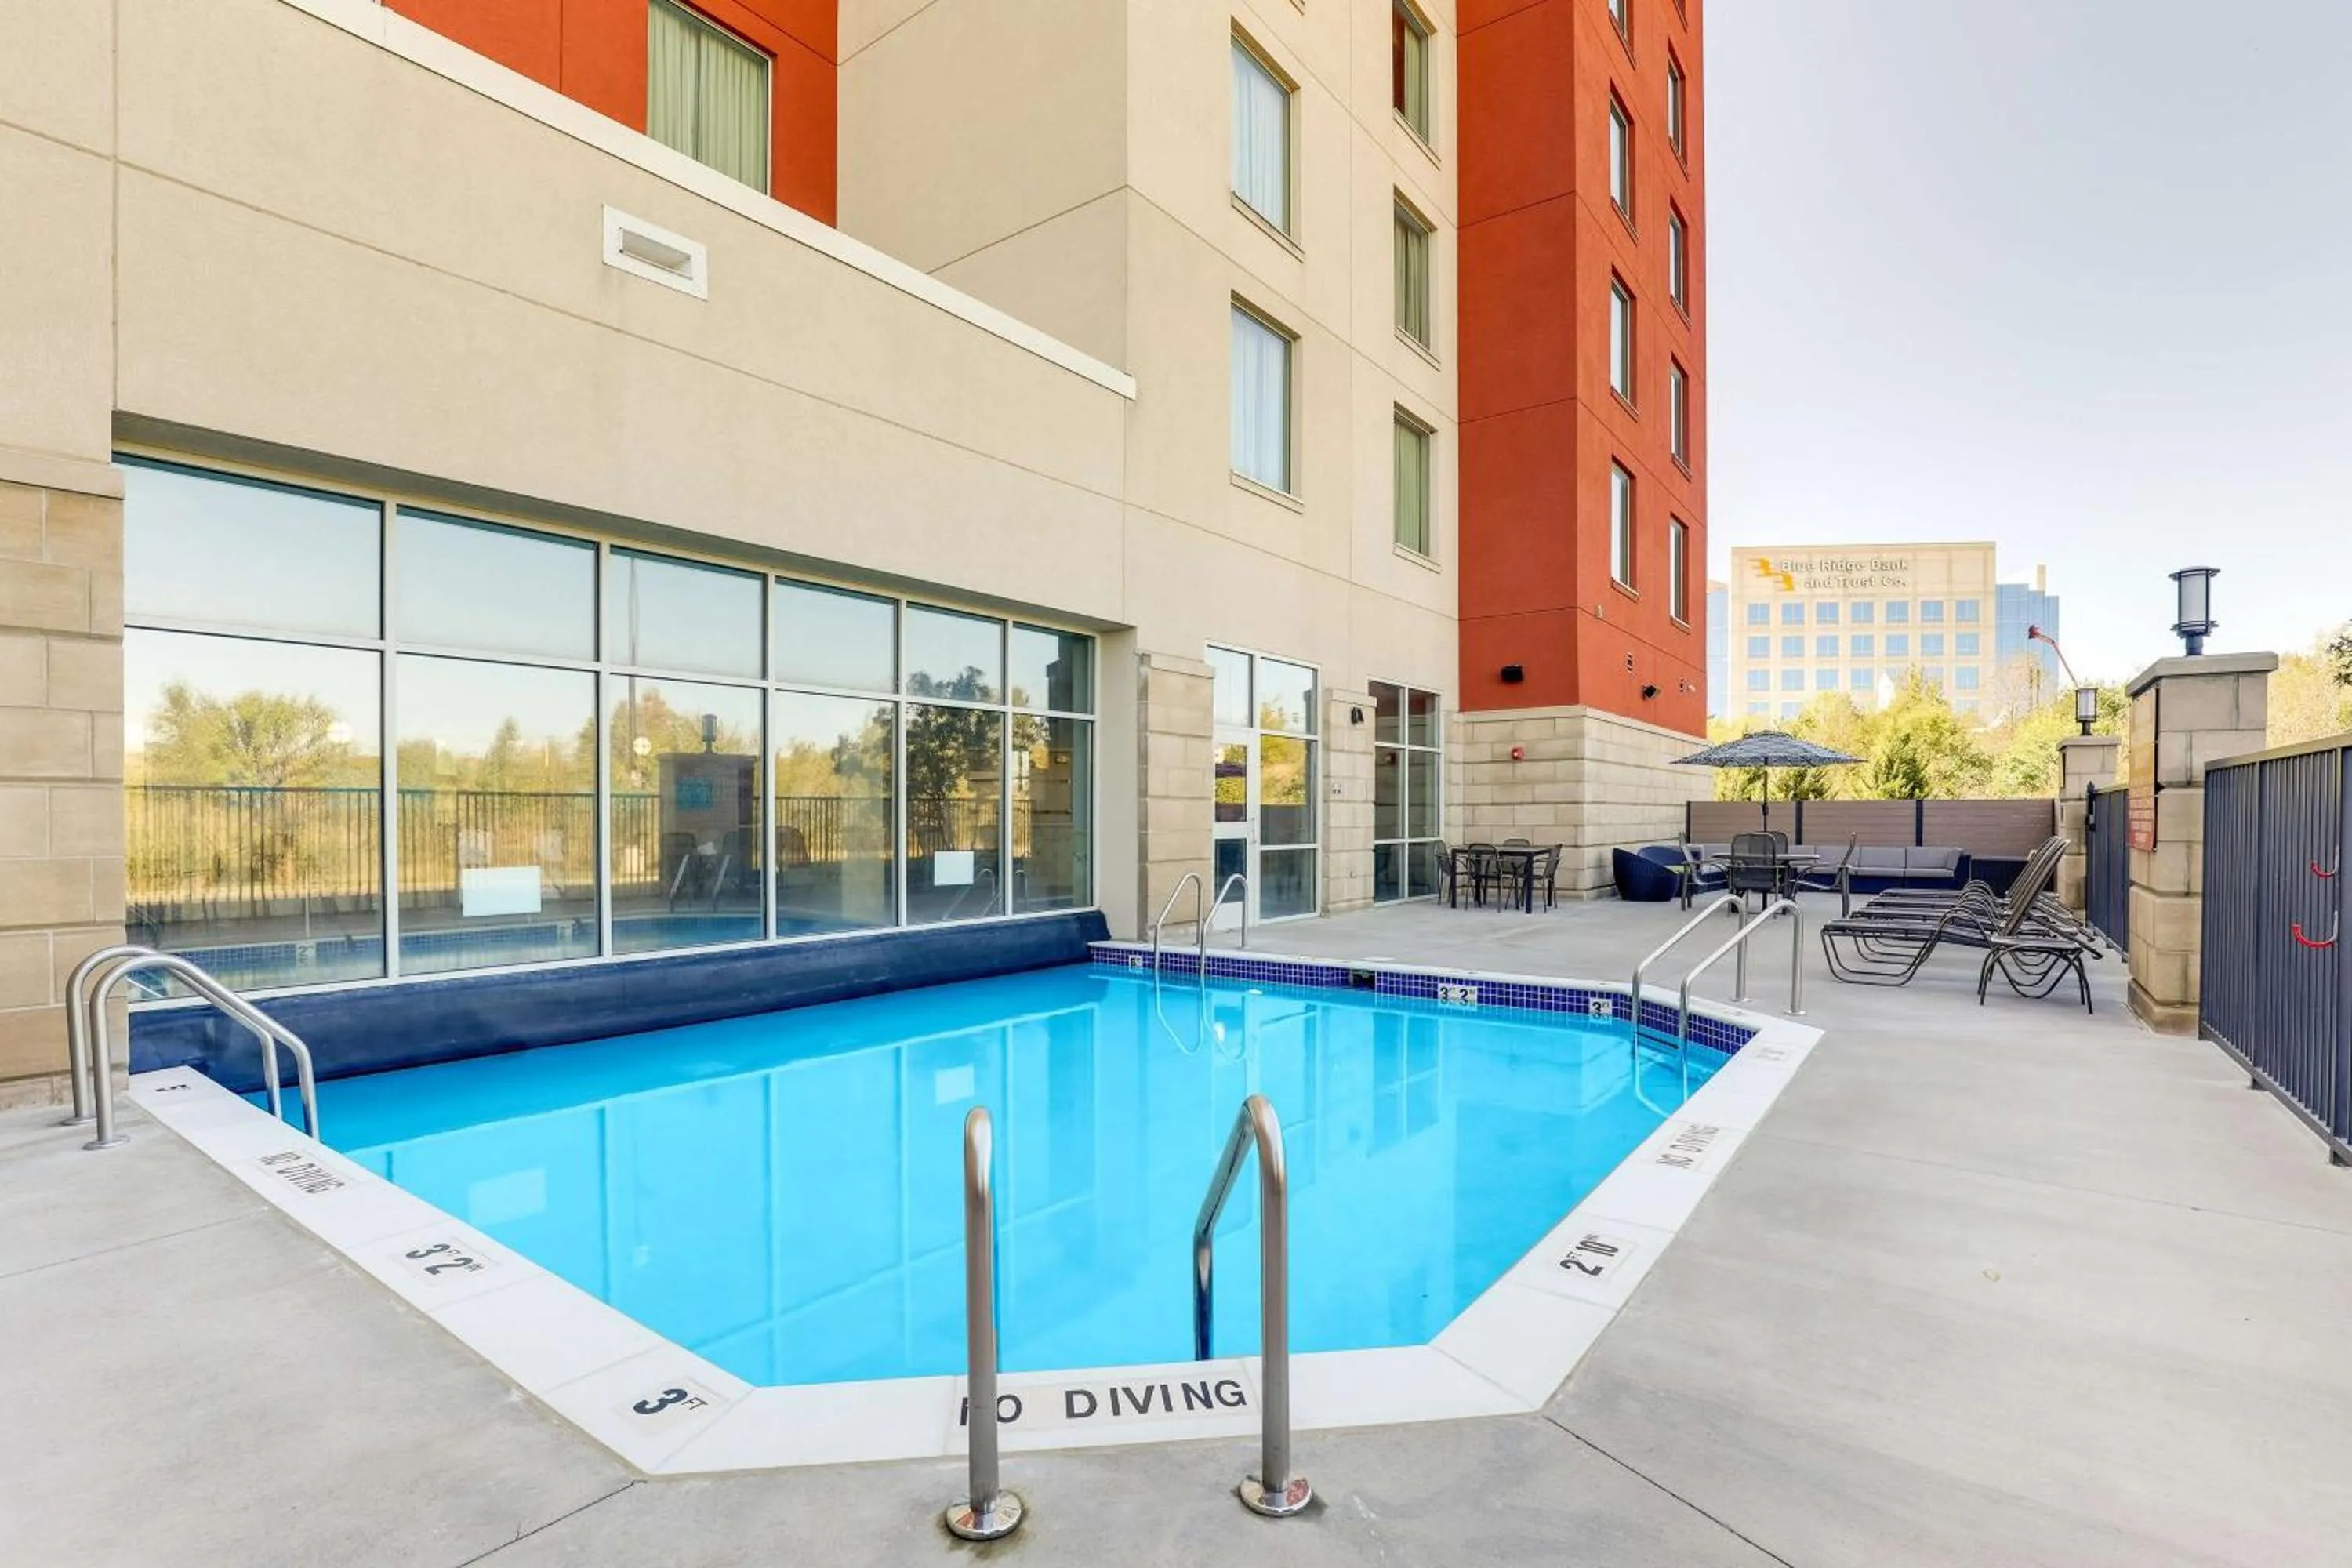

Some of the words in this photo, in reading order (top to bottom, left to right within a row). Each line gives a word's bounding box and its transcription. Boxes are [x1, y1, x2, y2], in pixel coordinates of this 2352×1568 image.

[1780, 559, 1814, 572] Blue
[1820, 560, 1865, 573] Ridge
[1870, 559, 1907, 572] Bank
[1804, 576, 1831, 589] and
[1836, 576, 1875, 588] Trust
[1881, 576, 1907, 588] Co.
[405, 1243, 451, 1259] 3
[1575, 1240, 1619, 1257] 10
[423, 1257, 474, 1276] 2
[1559, 1259, 1605, 1276] 2
[633, 1388, 688, 1415] 3
[681, 1396, 710, 1411] FT
[1065, 1379, 1247, 1420] DIVING
